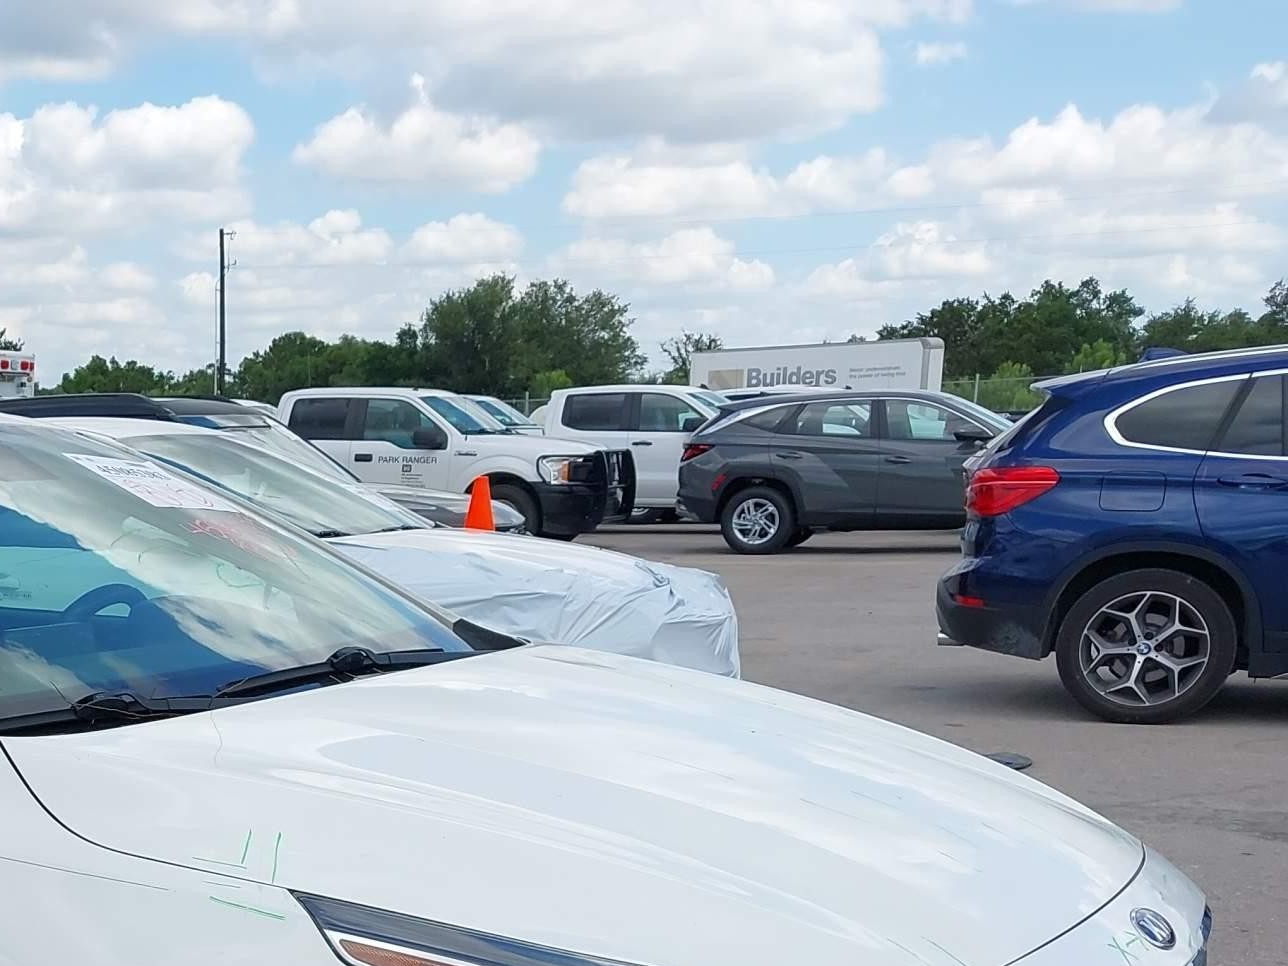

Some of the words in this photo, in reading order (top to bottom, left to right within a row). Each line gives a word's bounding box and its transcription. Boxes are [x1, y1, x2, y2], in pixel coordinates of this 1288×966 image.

[746, 366, 837, 388] Builders
[378, 456, 400, 464] PARK
[402, 456, 438, 464] RANGER
